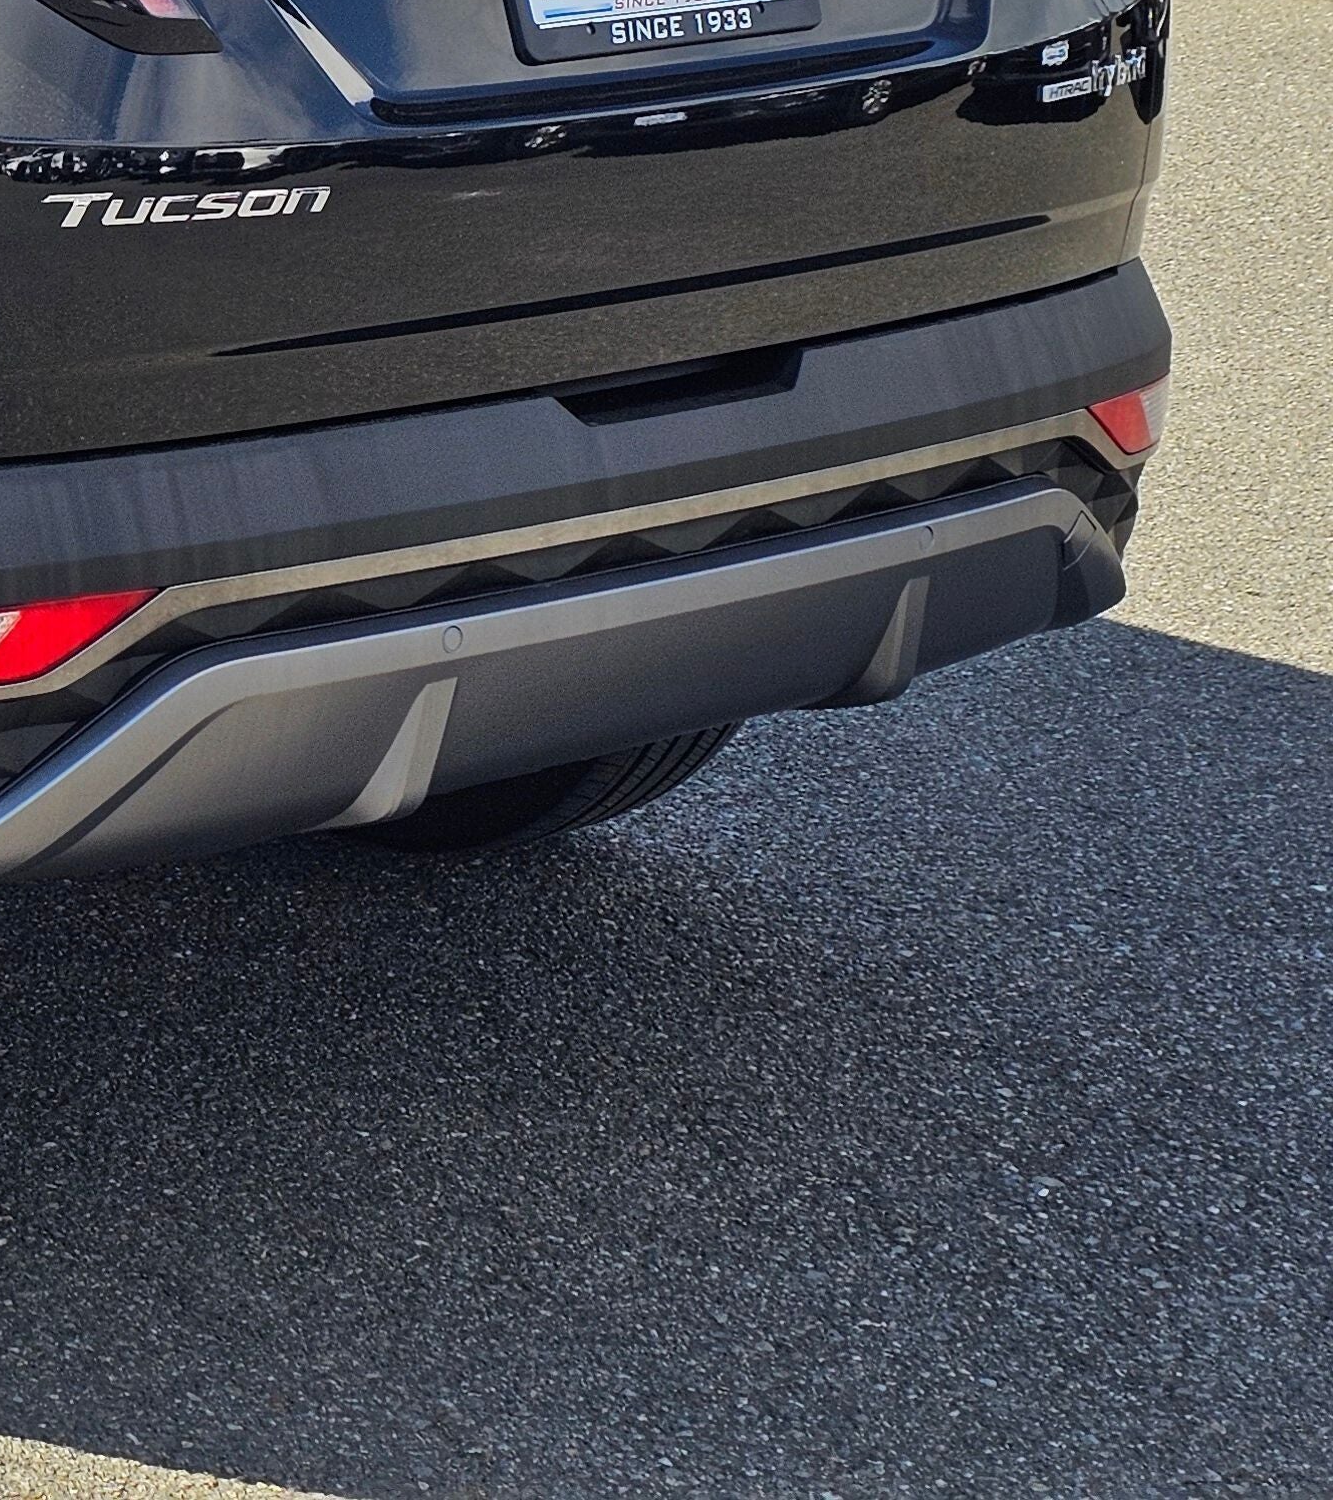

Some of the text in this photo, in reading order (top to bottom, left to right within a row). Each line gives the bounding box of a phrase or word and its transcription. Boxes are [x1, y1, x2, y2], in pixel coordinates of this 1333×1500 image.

[611, 6, 753, 45] SINCE 1933
[1049, 80, 1090, 100] HTRAC
